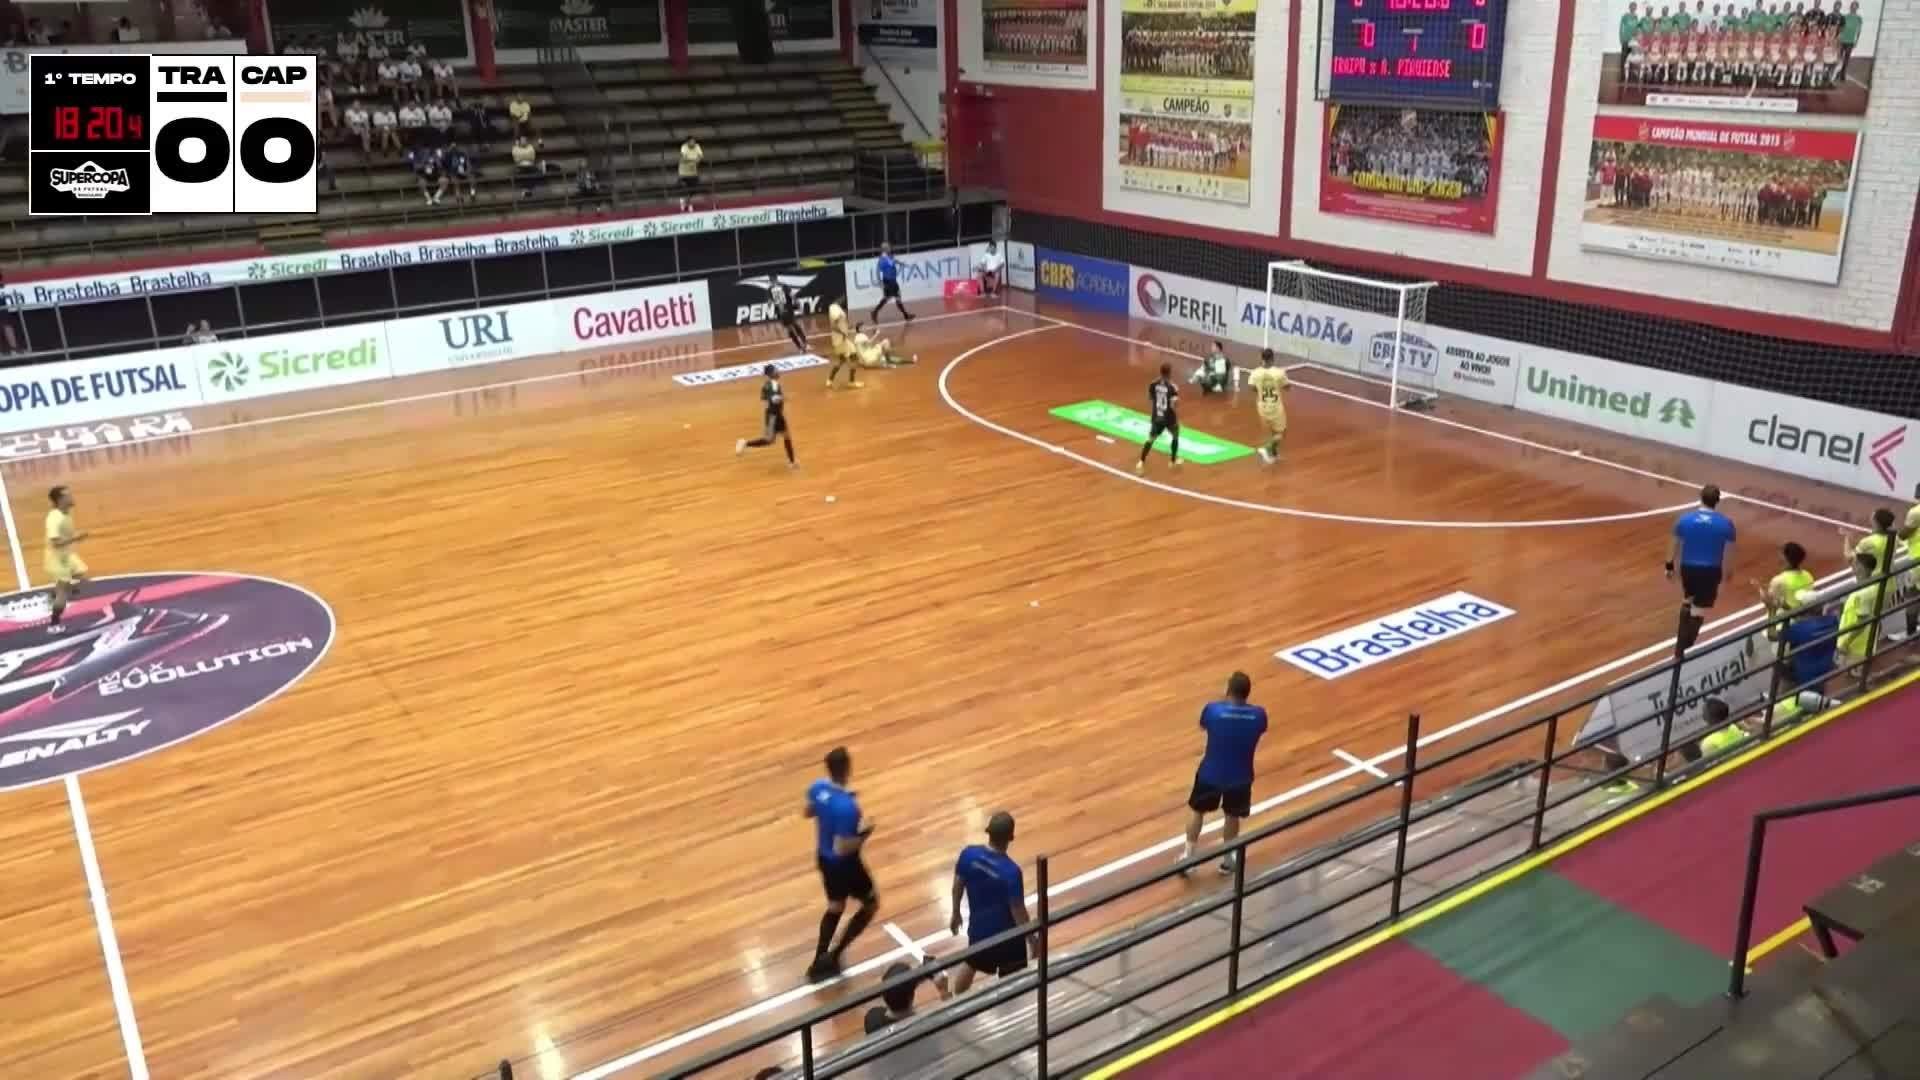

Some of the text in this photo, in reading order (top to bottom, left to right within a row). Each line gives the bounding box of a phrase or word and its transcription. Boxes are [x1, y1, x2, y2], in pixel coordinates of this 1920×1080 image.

[1363, 22, 1376, 48] 0
[1471, 23, 1487, 49] 0
[1163, 97, 1210, 115] CAMPEÃO
[34, 280, 121, 303] Brastelha
[130, 270, 212, 295] Brastelha
[270, 258, 328, 277] Sicredi
[340, 249, 411, 271] Brastelha
[419, 241, 487, 261] Brastelha
[495, 233, 559, 254] Brastelha
[588, 226, 634, 242] Sicredi
[660, 217, 704, 234] Sicredi
[729, 212, 770, 227] Sicredi
[775, 206, 828, 223] Brastelha
[439, 310, 513, 350] URI
[573, 293, 697, 341] Cavaletti
[1167, 293, 1228, 328] PERFIL
[1241, 302, 1353, 346] ATACADÃO
[258, 338, 376, 381] Sicredi
[1409, 348, 1433, 369] TV
[51, 375, 89, 405] DE
[89, 363, 187, 400] FUTSAL
[1526, 365, 1651, 418] Unimed
[1747, 414, 1864, 465] clanel
[1291, 600, 1501, 673] Brastelha
